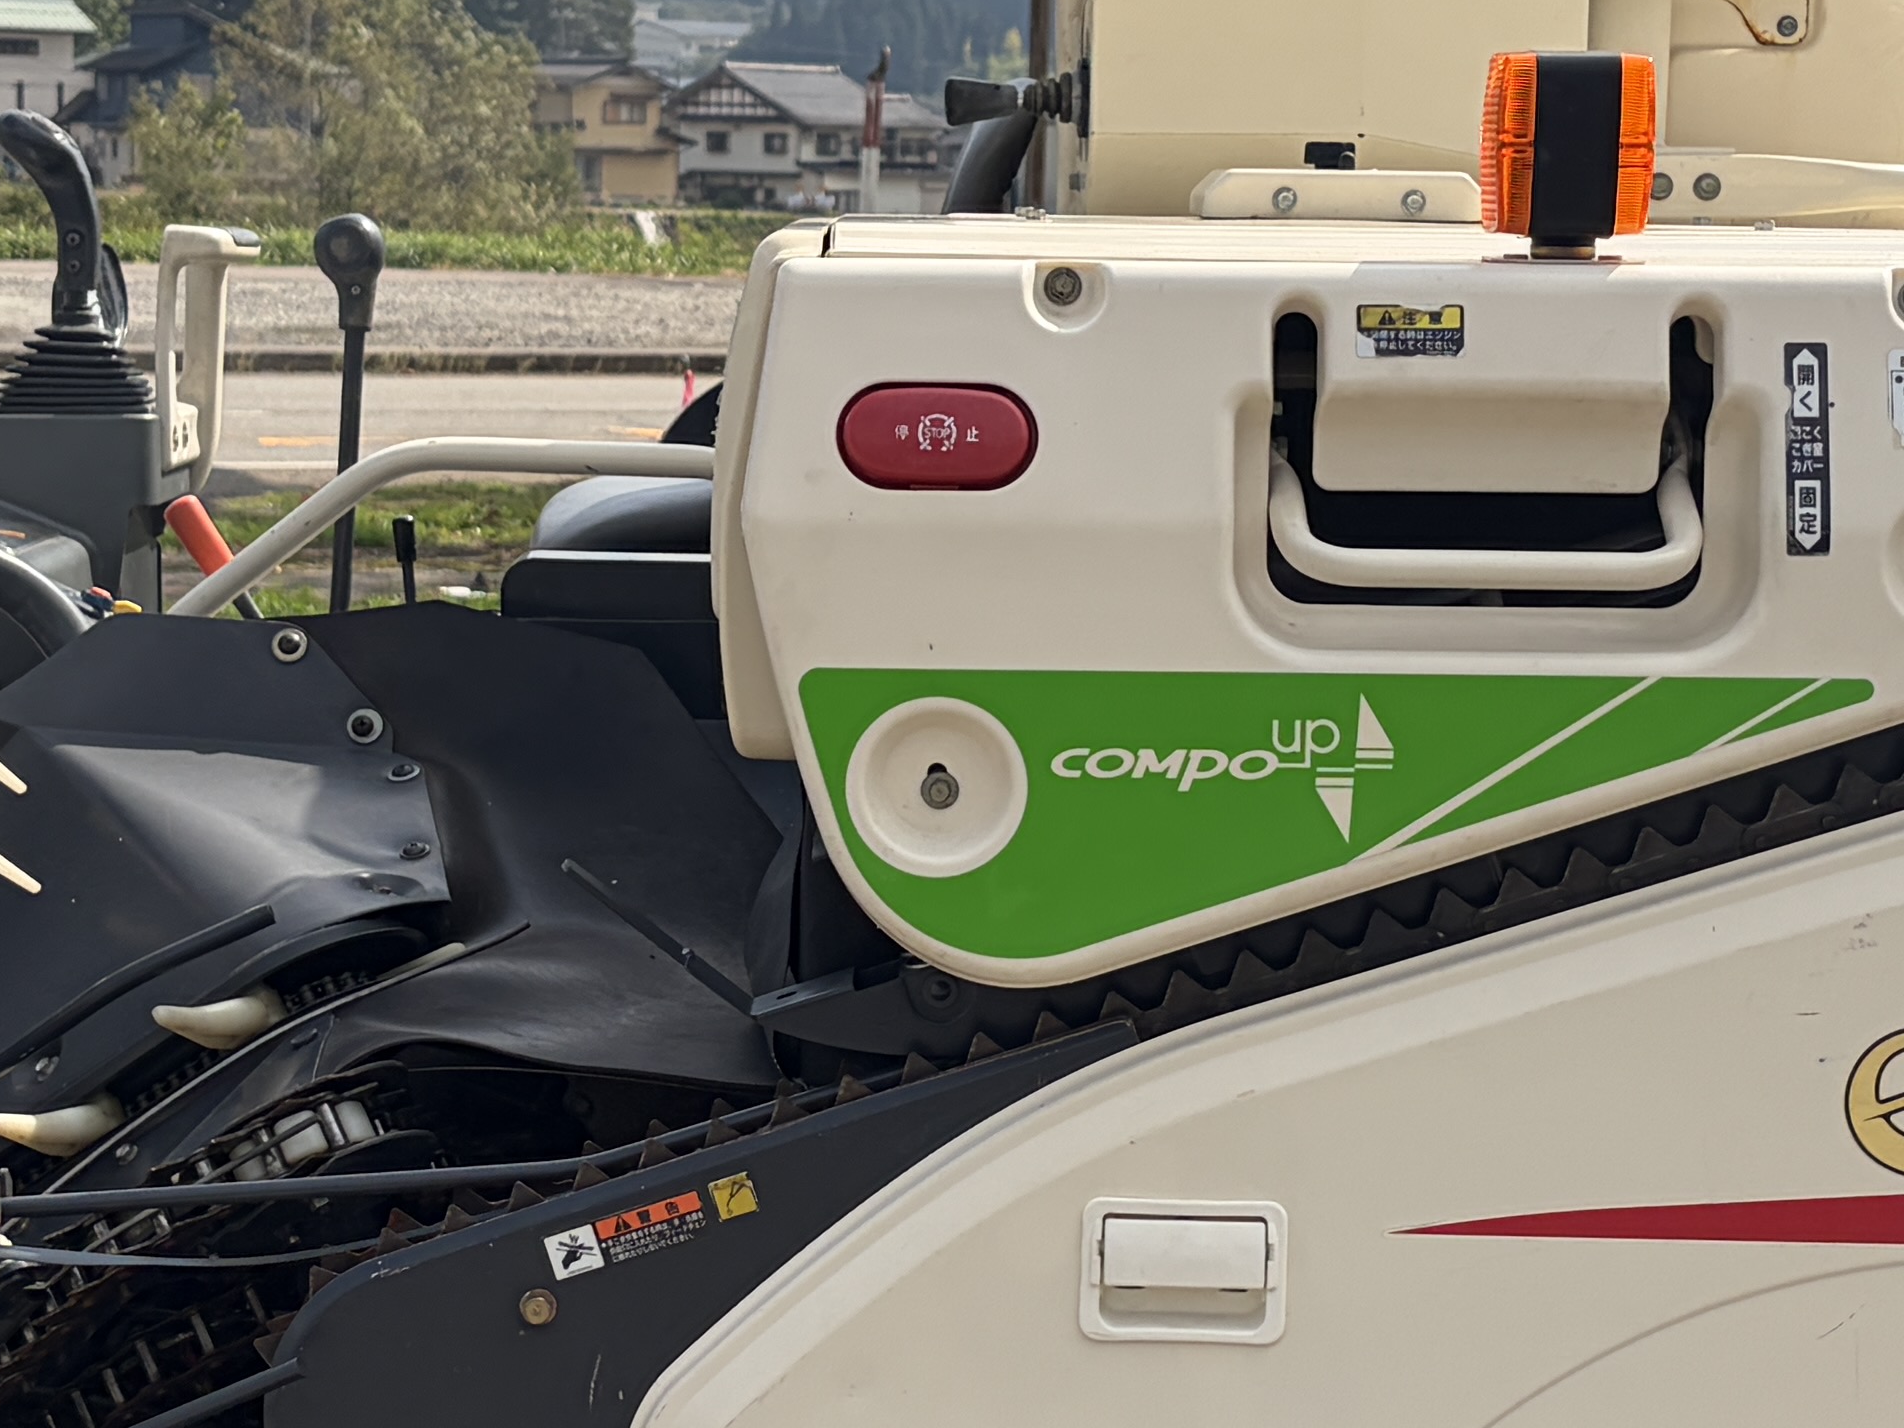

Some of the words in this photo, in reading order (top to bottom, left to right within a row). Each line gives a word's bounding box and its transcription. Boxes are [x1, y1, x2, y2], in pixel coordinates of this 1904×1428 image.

[1797, 364, 1815, 412] 開く
[924, 427, 951, 439] STOP
[1799, 486, 1817, 535] 固定
